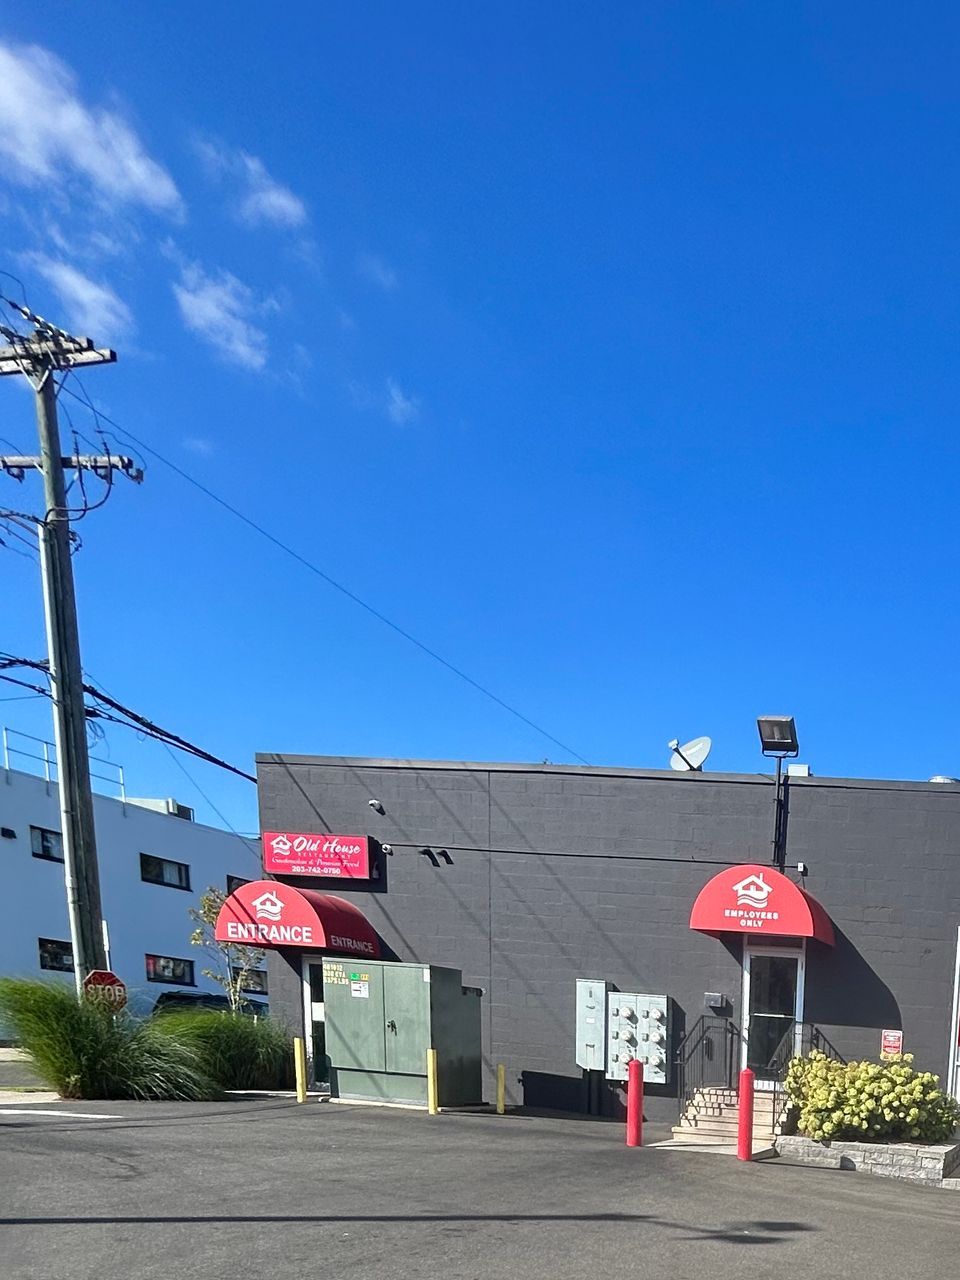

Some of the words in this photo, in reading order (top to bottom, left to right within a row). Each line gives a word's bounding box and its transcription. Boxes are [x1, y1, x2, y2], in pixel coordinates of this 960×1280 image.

[293, 836, 320, 852] Old
[323, 838, 361, 854] House
[724, 909, 779, 920] EMPLOYEES
[740, 919, 763, 927] ONLY
[227, 922, 313, 943] ENTRANCE
[330, 935, 374, 953] ENTRANCE
[87, 984, 125, 1001] STOP
